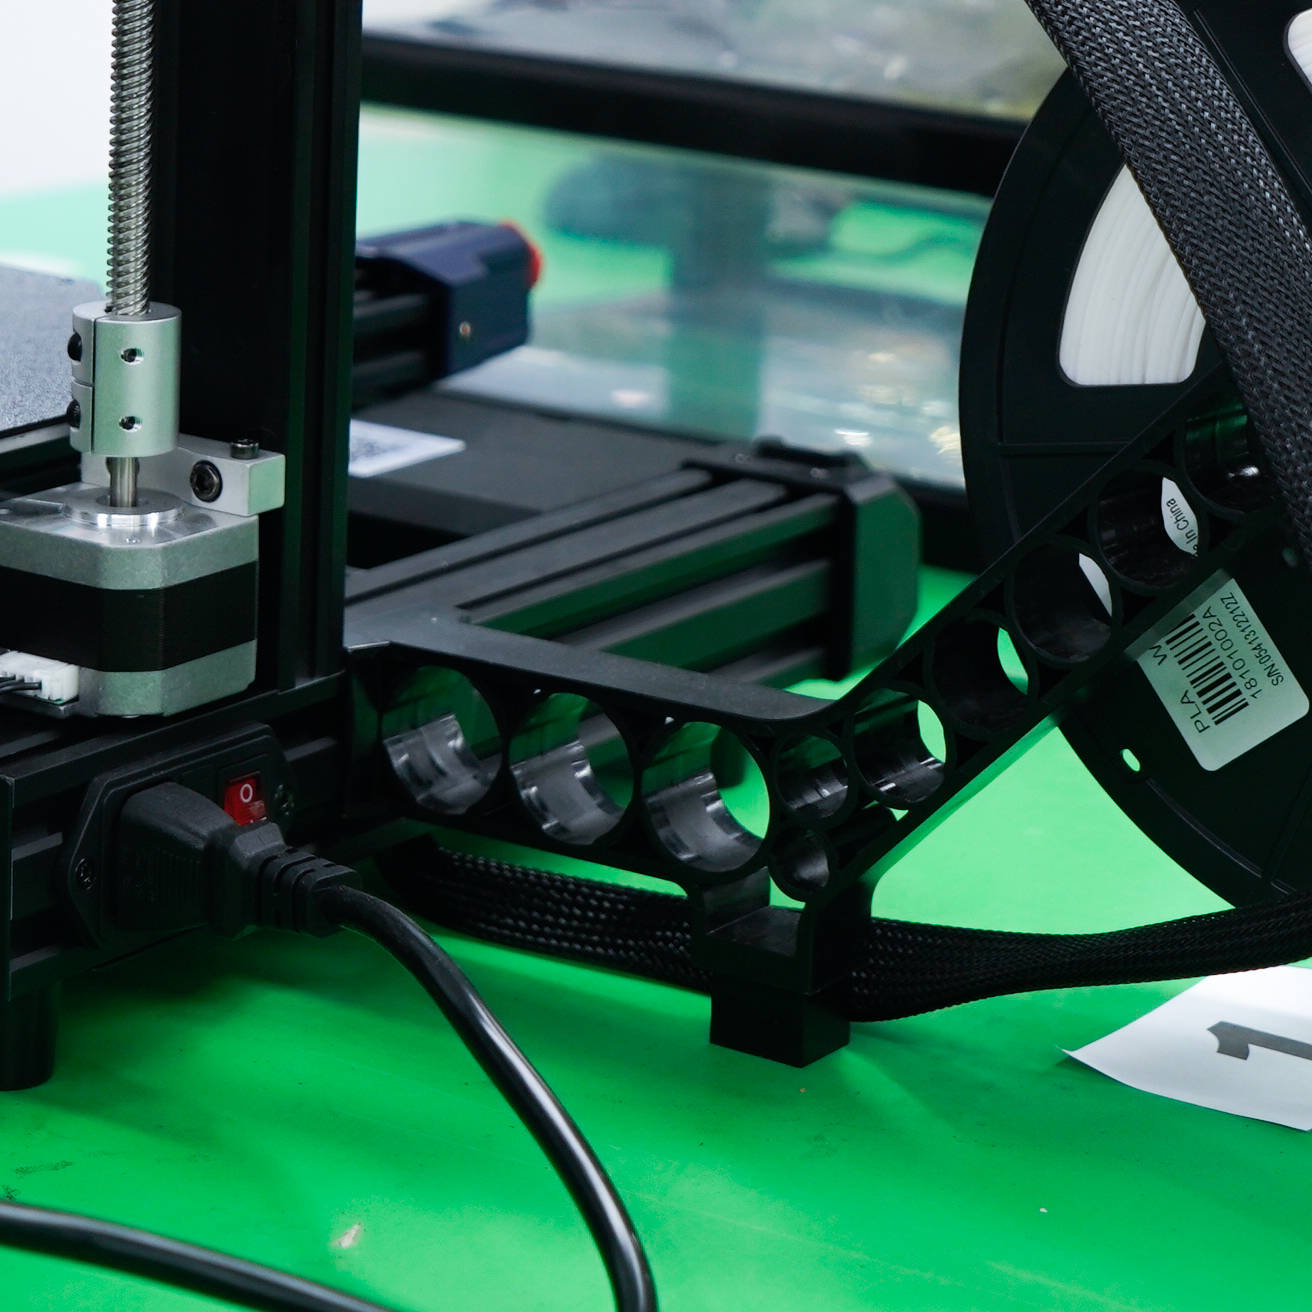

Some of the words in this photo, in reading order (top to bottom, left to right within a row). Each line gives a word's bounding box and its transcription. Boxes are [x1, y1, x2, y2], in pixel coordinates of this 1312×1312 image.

[1166, 497, 1190, 531] China
[1185, 529, 1198, 545] In
[1202, 606, 1264, 699] 18101002A
[1180, 689, 1210, 733] PLA
